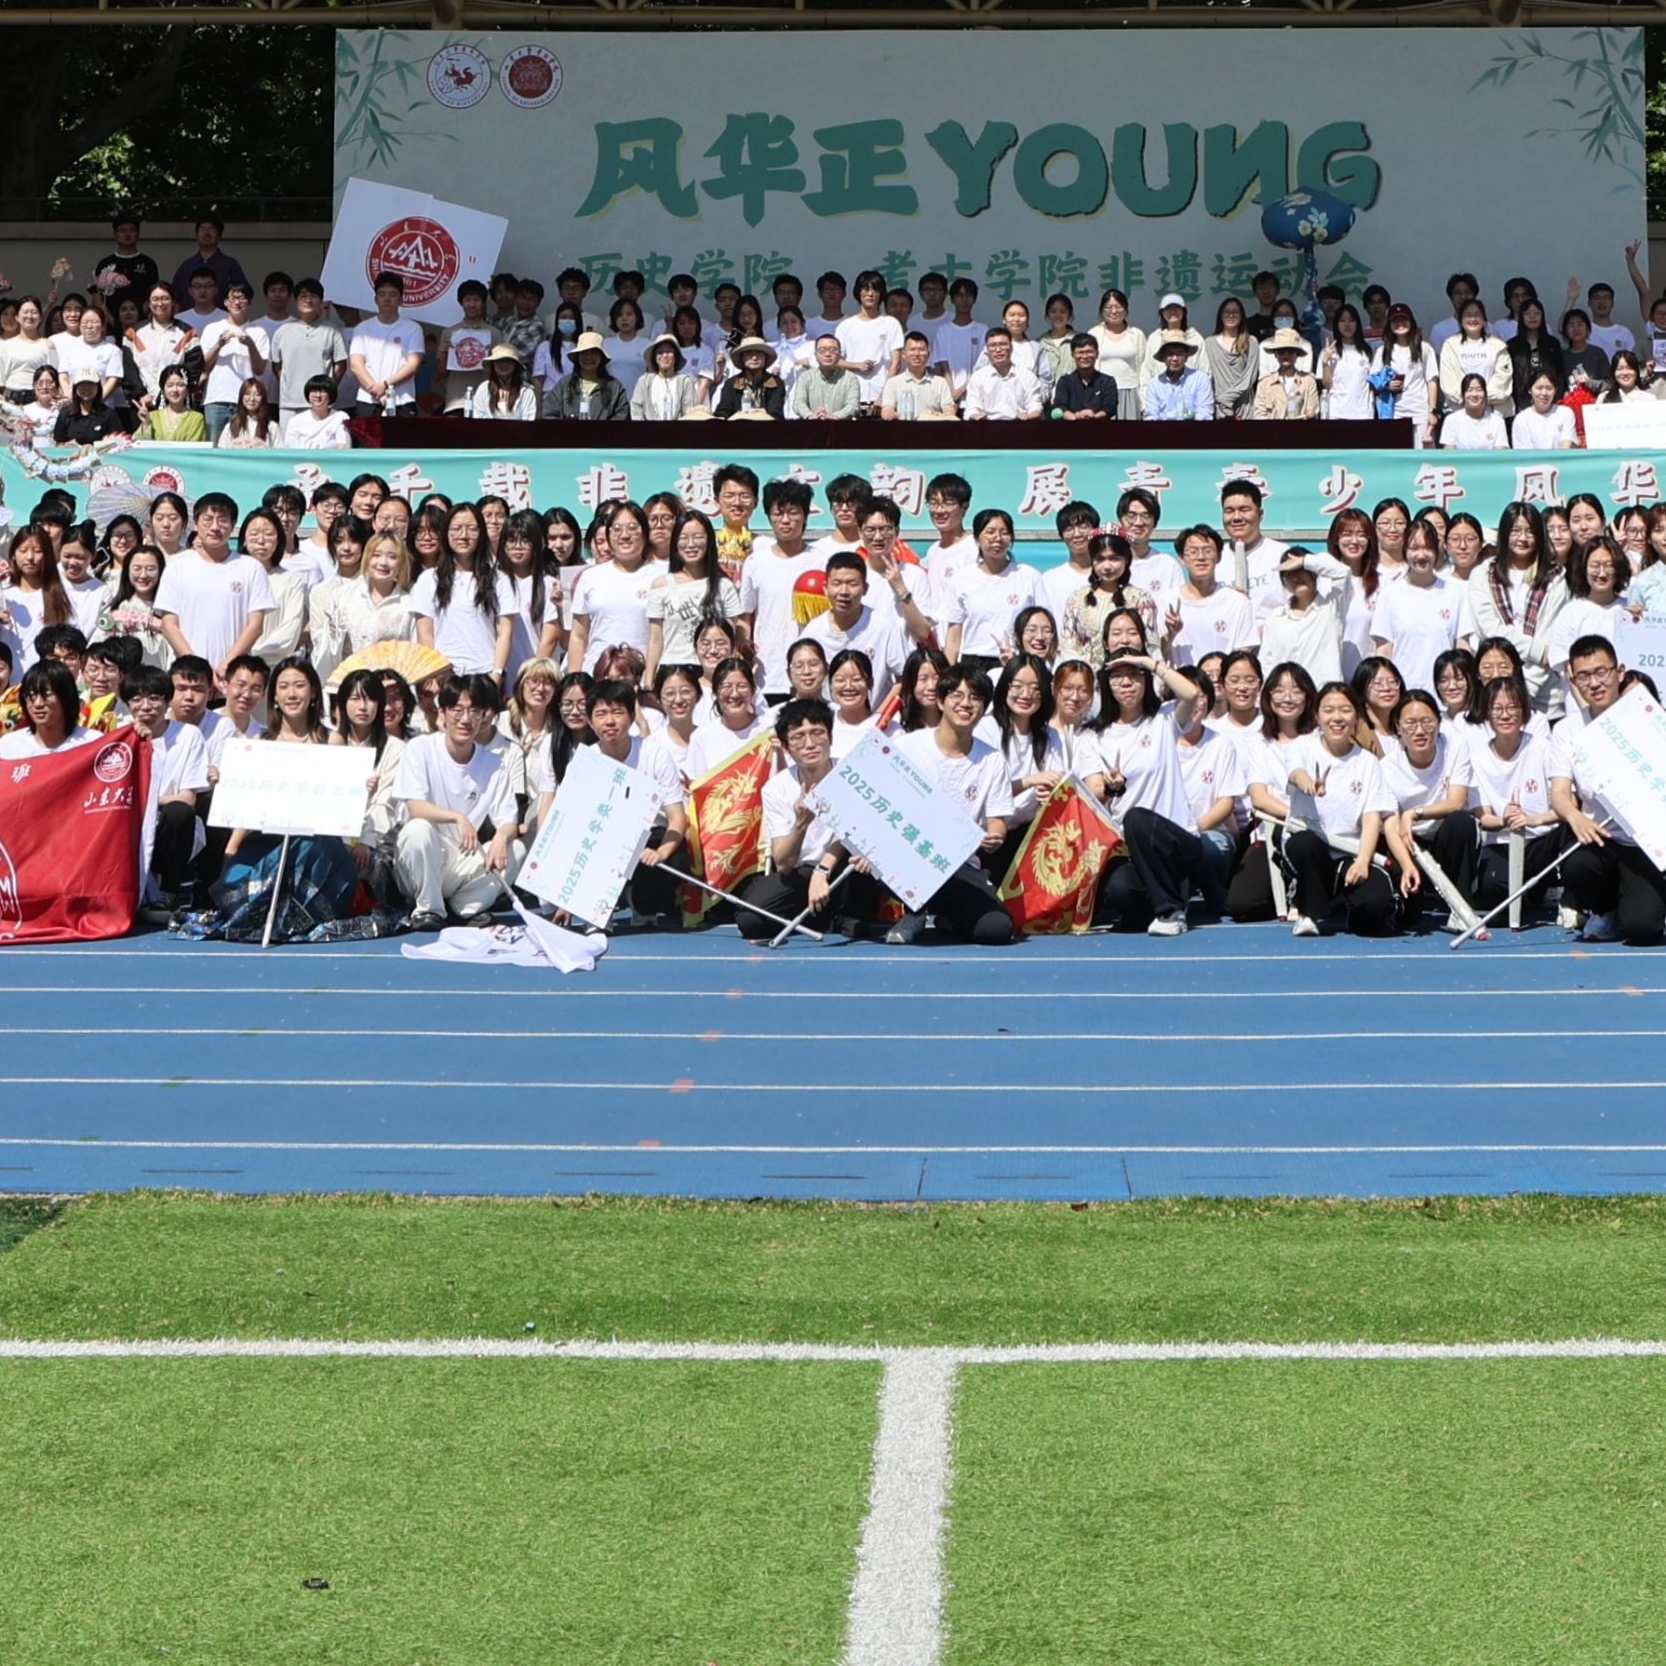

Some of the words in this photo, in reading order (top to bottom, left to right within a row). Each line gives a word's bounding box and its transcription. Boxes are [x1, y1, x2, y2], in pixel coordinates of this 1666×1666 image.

[402, 273, 451, 304] UNIVERSITY
[577, 248, 794, 300] 历史学院
[557, 766, 628, 905] 2025历史学类一班
[837, 764, 952, 875] 2025历史强基班
